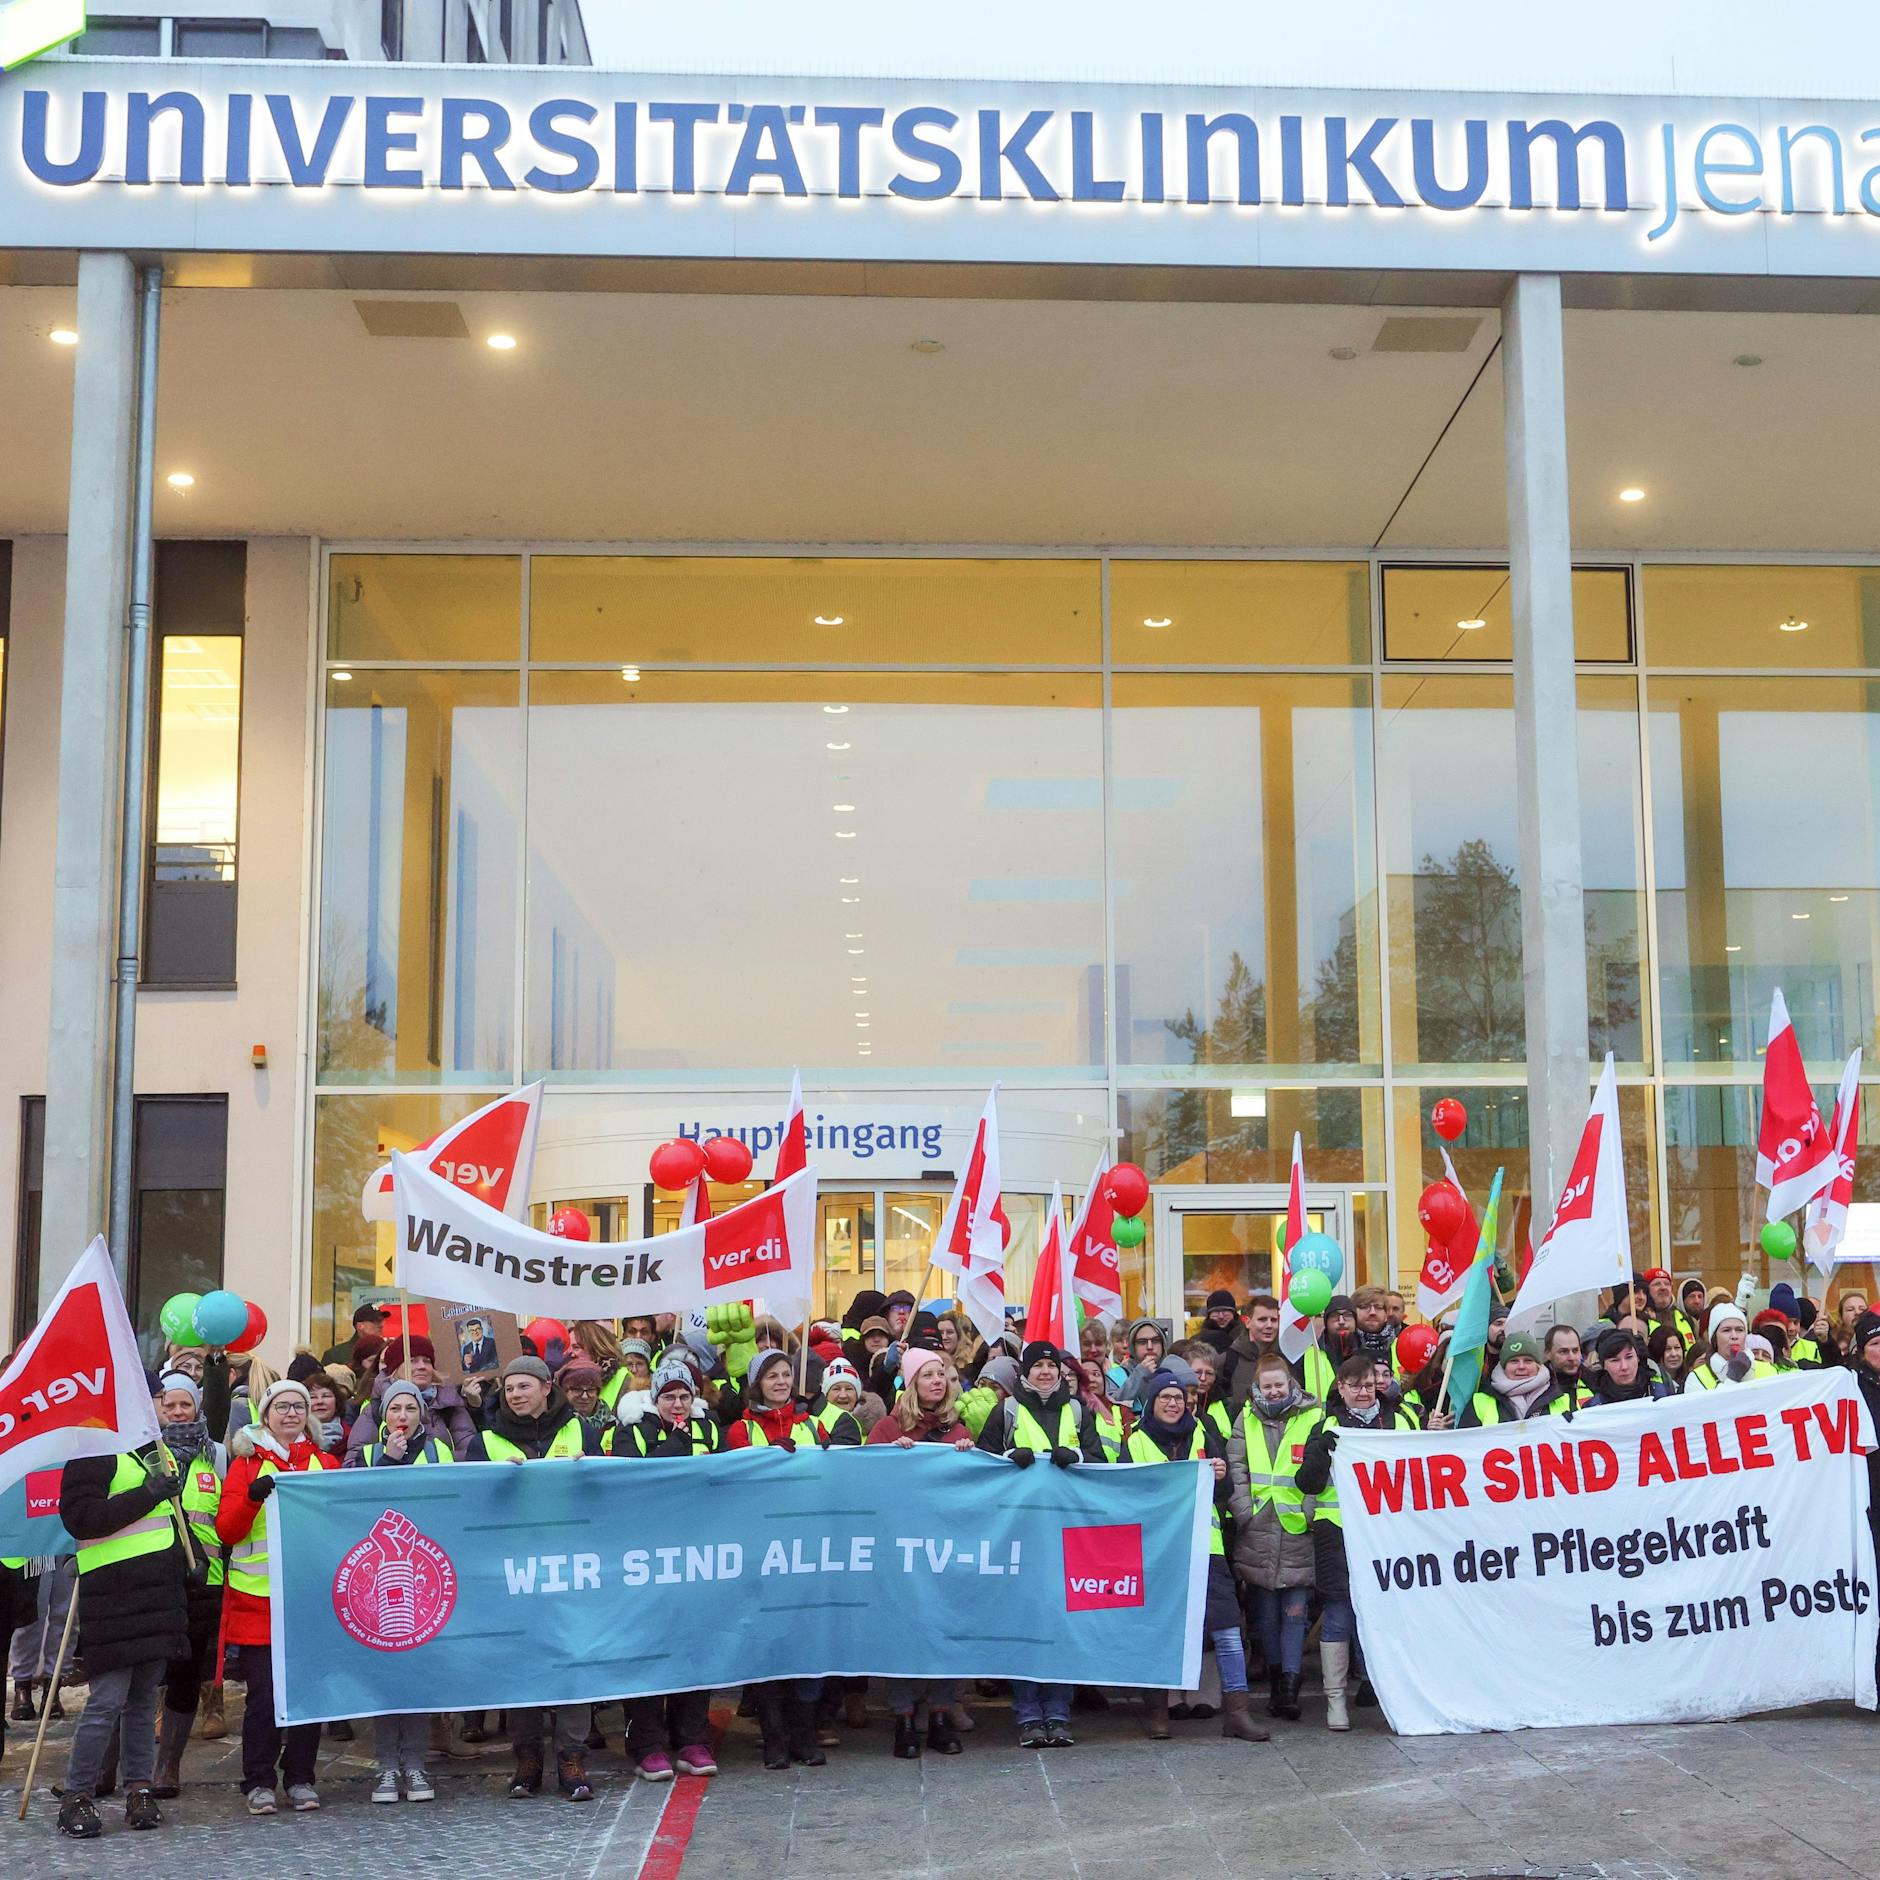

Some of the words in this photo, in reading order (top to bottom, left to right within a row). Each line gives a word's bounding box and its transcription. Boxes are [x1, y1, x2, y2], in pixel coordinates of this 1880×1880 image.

[406, 1214, 666, 1288] Warnstreik
[708, 1236, 783, 1271] ver.di
[1352, 1454, 1470, 1516] WIR
[1482, 1439, 1619, 1503] SIND
[1637, 1413, 1776, 1488] ALLE
[1781, 1398, 1867, 1462] TVL
[337, 1567, 352, 1594] WIR
[346, 1540, 374, 1567] SIND
[415, 1537, 445, 1562] ALLE
[504, 1552, 601, 1595] WIR
[622, 1542, 744, 1587] SIND
[760, 1536, 876, 1576] ALLE
[895, 1537, 1022, 1575] TV-L!
[1372, 1550, 1442, 1592] von
[1453, 1539, 1520, 1584] der
[1531, 1505, 1772, 1579] Pflegekraft
[1069, 1575, 1138, 1596] ver.di
[340, 1606, 352, 1621] Für
[347, 1621, 367, 1640] gute
[366, 1634, 395, 1648] Löhne
[395, 1637, 415, 1648] und
[413, 1626, 435, 1643] gute
[432, 1599, 451, 1627] Arbeit
[1590, 1600, 1654, 1647] bis
[1665, 1594, 1751, 1639] zum
